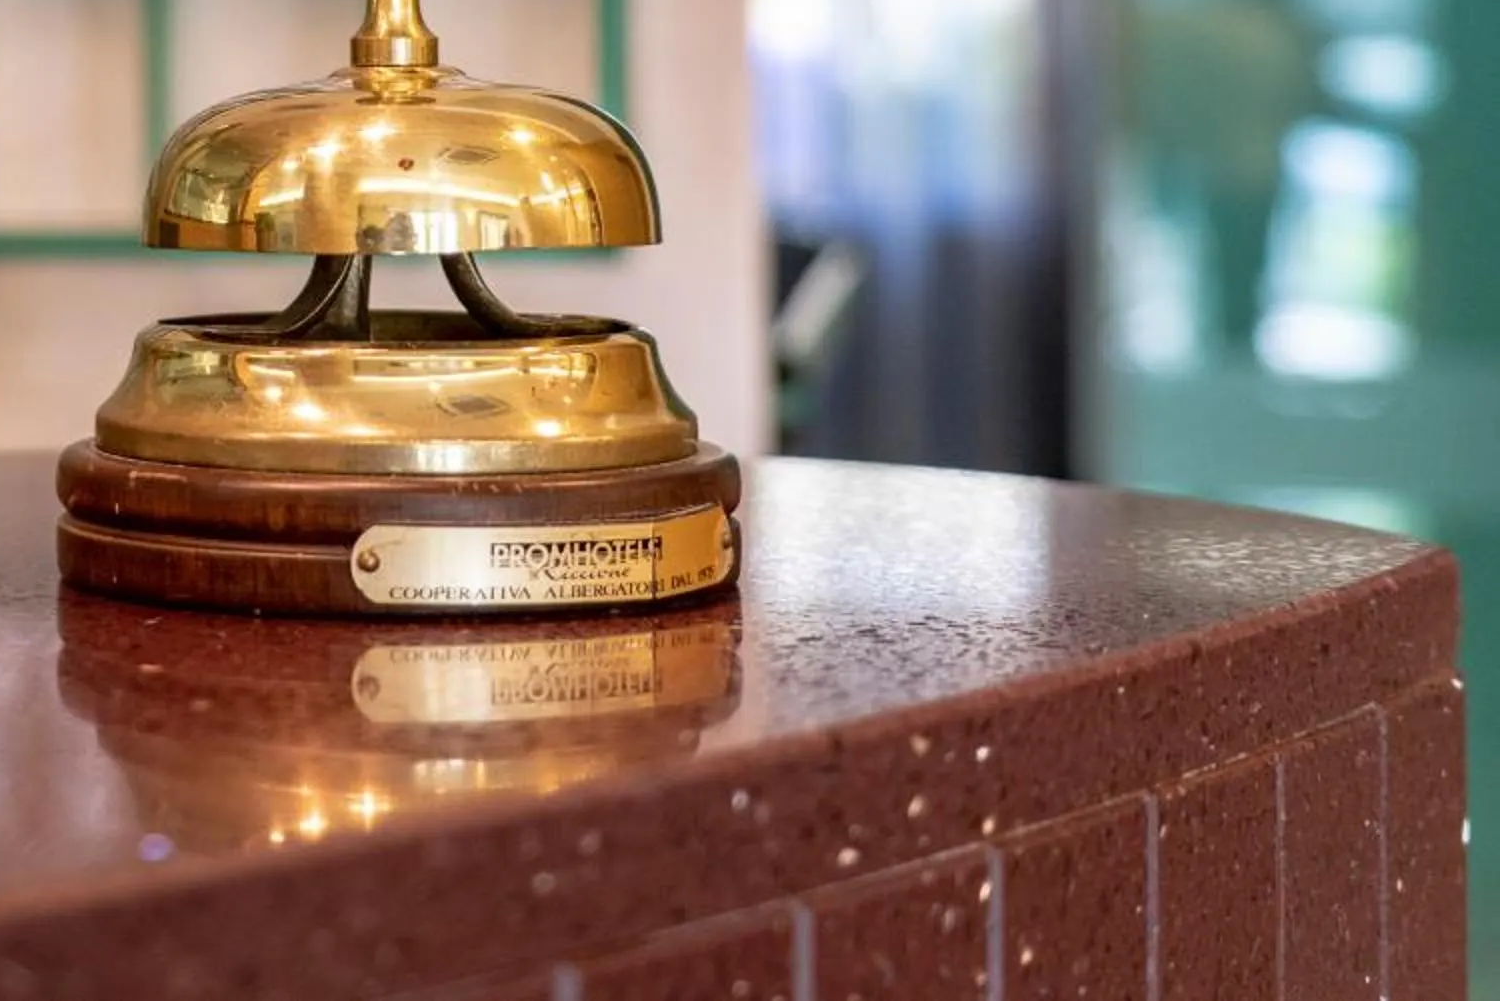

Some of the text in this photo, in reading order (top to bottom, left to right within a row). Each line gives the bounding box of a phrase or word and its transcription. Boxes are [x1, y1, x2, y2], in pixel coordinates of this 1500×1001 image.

[491, 536, 662, 569] PROMHOTELS
[388, 584, 532, 600] COOPERATIVA
[544, 577, 665, 599] ALBERGATORI
[671, 572, 693, 590] DAL
